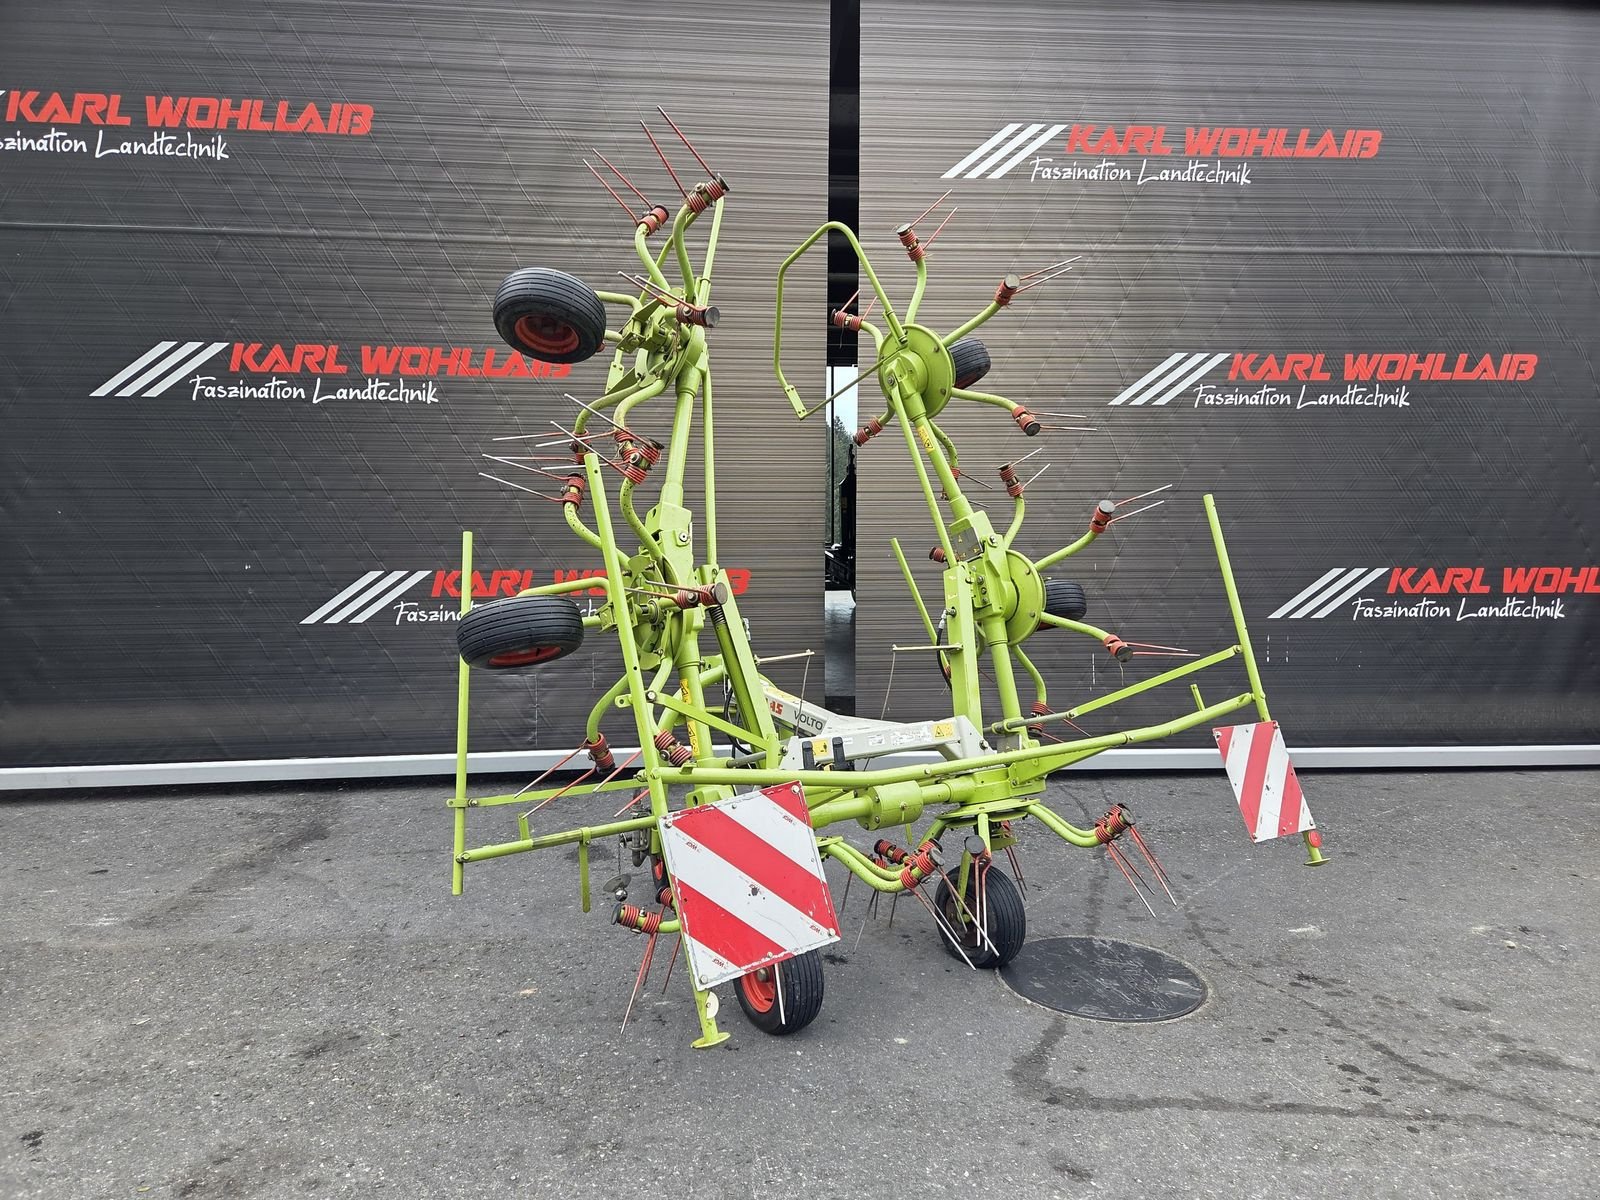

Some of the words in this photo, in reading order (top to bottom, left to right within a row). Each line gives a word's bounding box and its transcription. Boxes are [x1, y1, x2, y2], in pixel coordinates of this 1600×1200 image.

[6, 91, 131, 126] KARL
[95, 130, 229, 161] Landtechnik
[1066, 124, 1172, 155] KARL
[1030, 156, 1131, 183] Faszination
[1137, 158, 1251, 186] Landtechnik
[229, 342, 347, 374] KARL
[1228, 352, 1331, 381] KARL
[189, 374, 305, 400] Faszination
[312, 377, 439, 404] Landtechnik
[1193, 383, 1291, 408] Faszination
[1296, 384, 1410, 410] Landtechnik
[1386, 567, 1490, 594] KARL
[1502, 567, 1600, 594] WOHL
[1352, 596, 1451, 621] Faszination
[1456, 596, 1565, 622] Landtechnik
[794, 710, 823, 731] VOLTO
